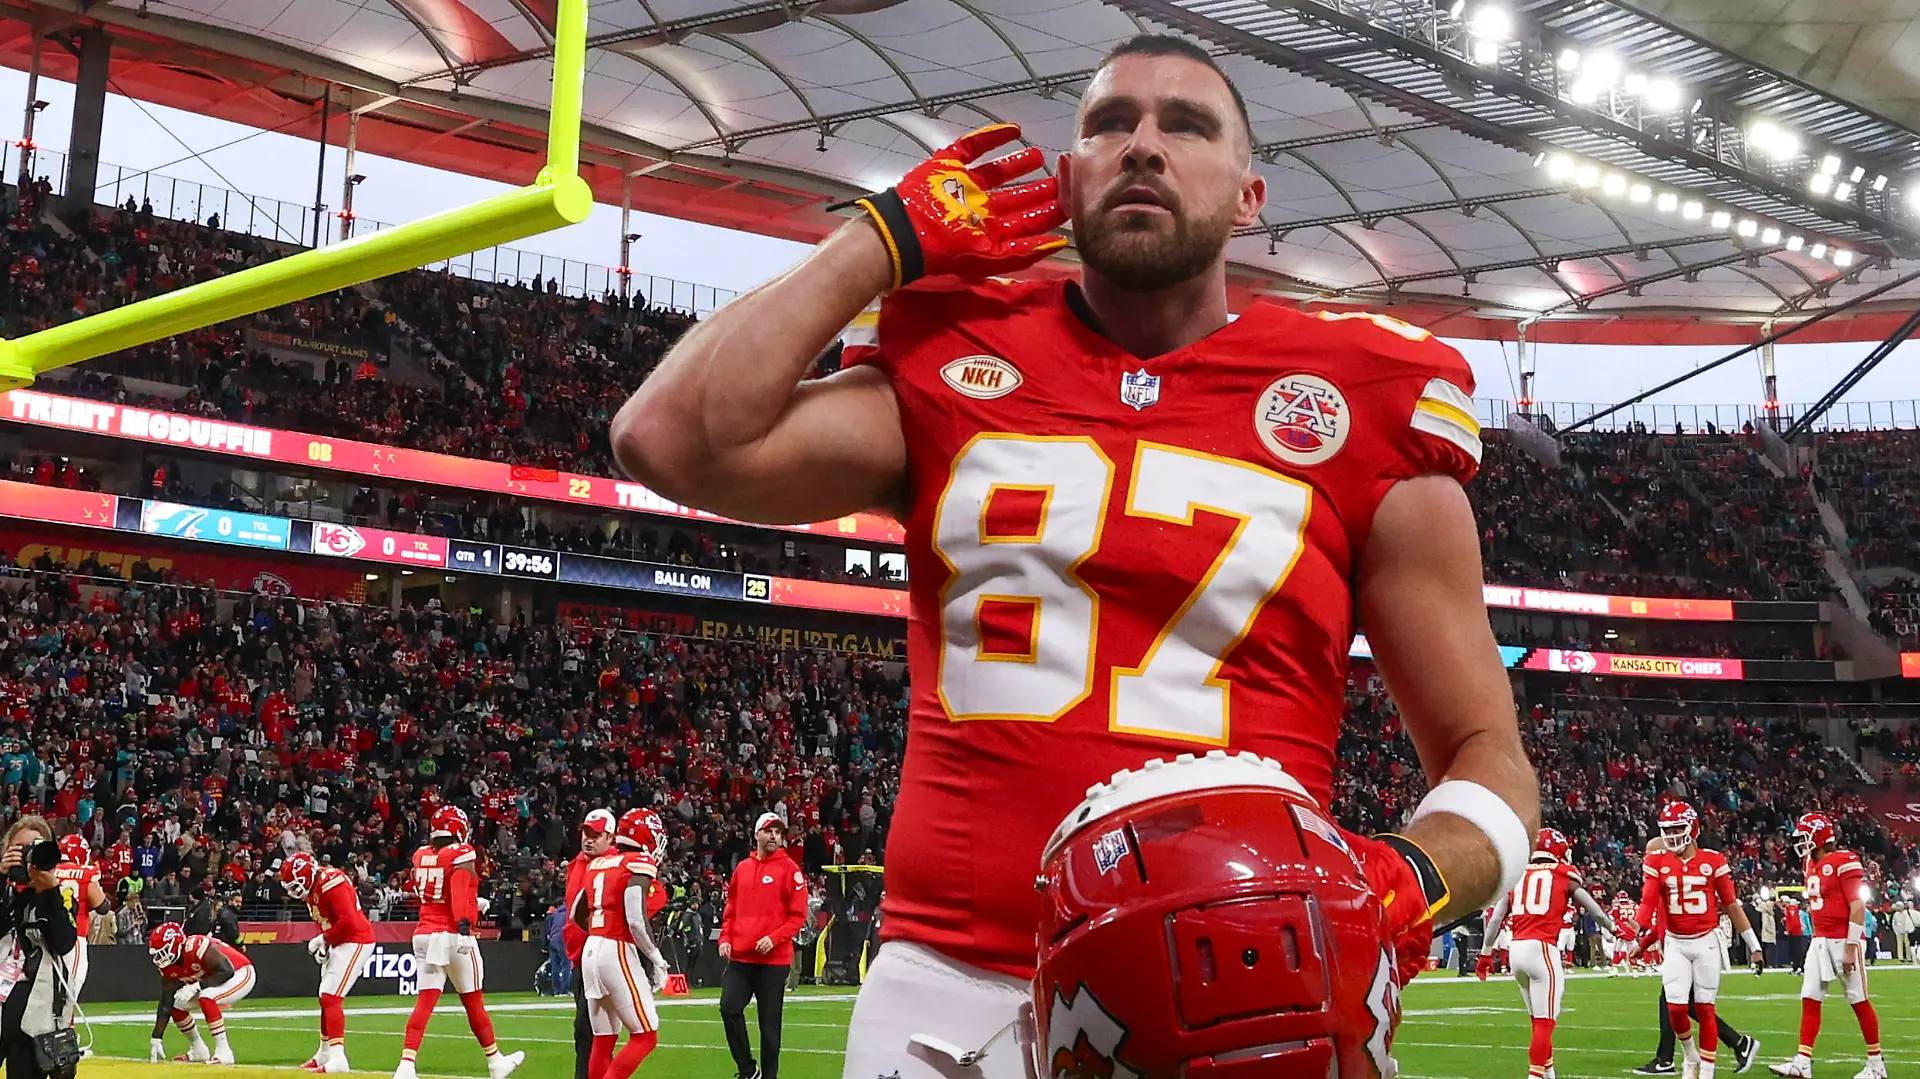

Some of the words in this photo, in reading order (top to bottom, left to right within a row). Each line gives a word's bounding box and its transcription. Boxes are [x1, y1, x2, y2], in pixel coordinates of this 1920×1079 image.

[293, 338, 339, 353] FRANKFURT
[341, 346, 368, 358] GAMES
[961, 366, 1003, 388] NKH
[1126, 386, 1151, 402] NFL
[9, 390, 115, 431] TRENT
[120, 408, 272, 455] MCDUFFIE
[568, 478, 591, 499] 22
[217, 516, 233, 536] 0
[382, 537, 395, 556] 0
[413, 541, 430, 552] TOL
[456, 550, 475, 563] QTR
[482, 549, 492, 567] 1
[505, 552, 553, 574] 39:56
[654, 570, 688, 588] BALL
[690, 574, 711, 590] ON
[747, 580, 766, 597] 25
[932, 431, 1312, 746] 87
[1613, 659, 1652, 672] KANSAS
[1655, 661, 1681, 673] CITY
[1682, 661, 1723, 675] CHIEFS
[141, 854, 153, 867] 16
[416, 867, 445, 904] 77
[1511, 869, 1553, 916] 10
[1665, 876, 1708, 915] 15
[592, 872, 606, 928] 1
[363, 946, 417, 978] rizo
[399, 977, 419, 995] bu
[670, 976, 686, 993] 20
